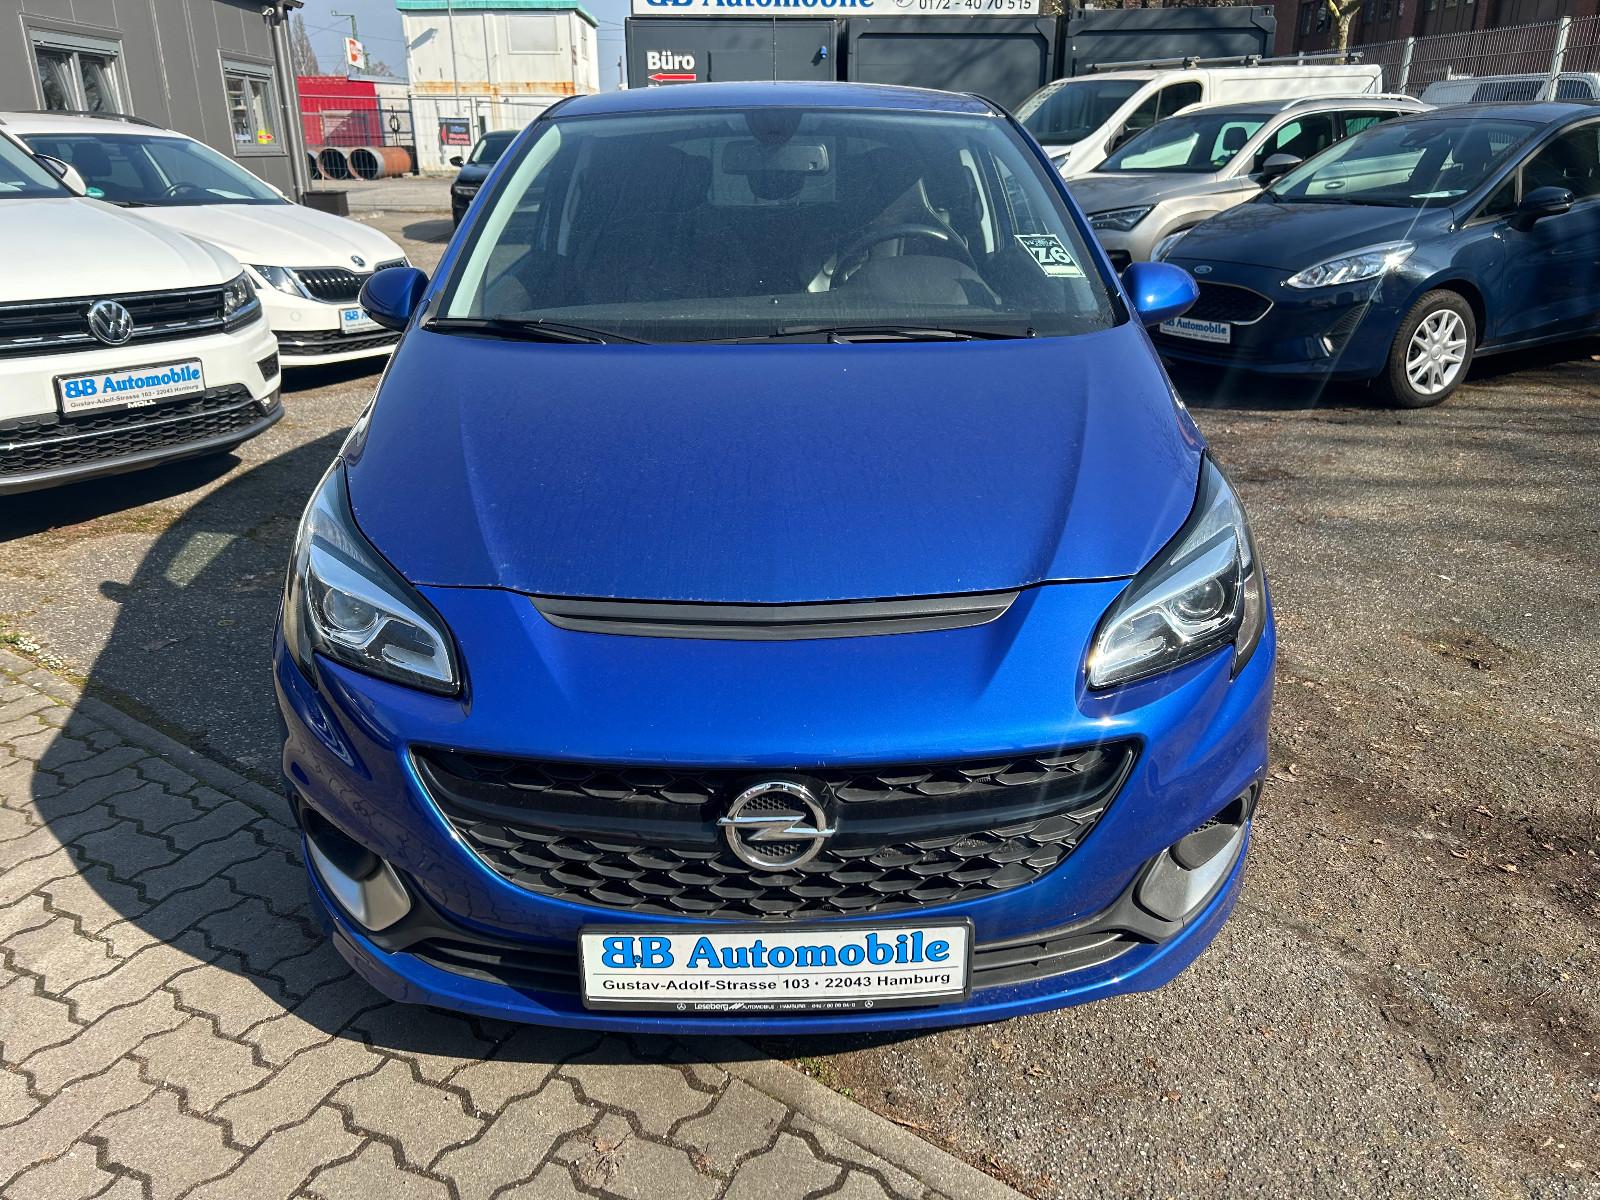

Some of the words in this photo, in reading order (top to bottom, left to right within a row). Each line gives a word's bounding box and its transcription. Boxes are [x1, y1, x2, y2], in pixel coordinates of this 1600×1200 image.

[646, 49, 695, 70] Büro
[1176, 318, 1227, 334] Automobile
[102, 365, 201, 394] Automobile
[687, 930, 951, 968] Automobile
[602, 977, 777, 991] Gustav-Adolf-Strasse
[783, 977, 810, 990] 103
[825, 976, 872, 988] 22043
[876, 972, 951, 987] Hamburg
